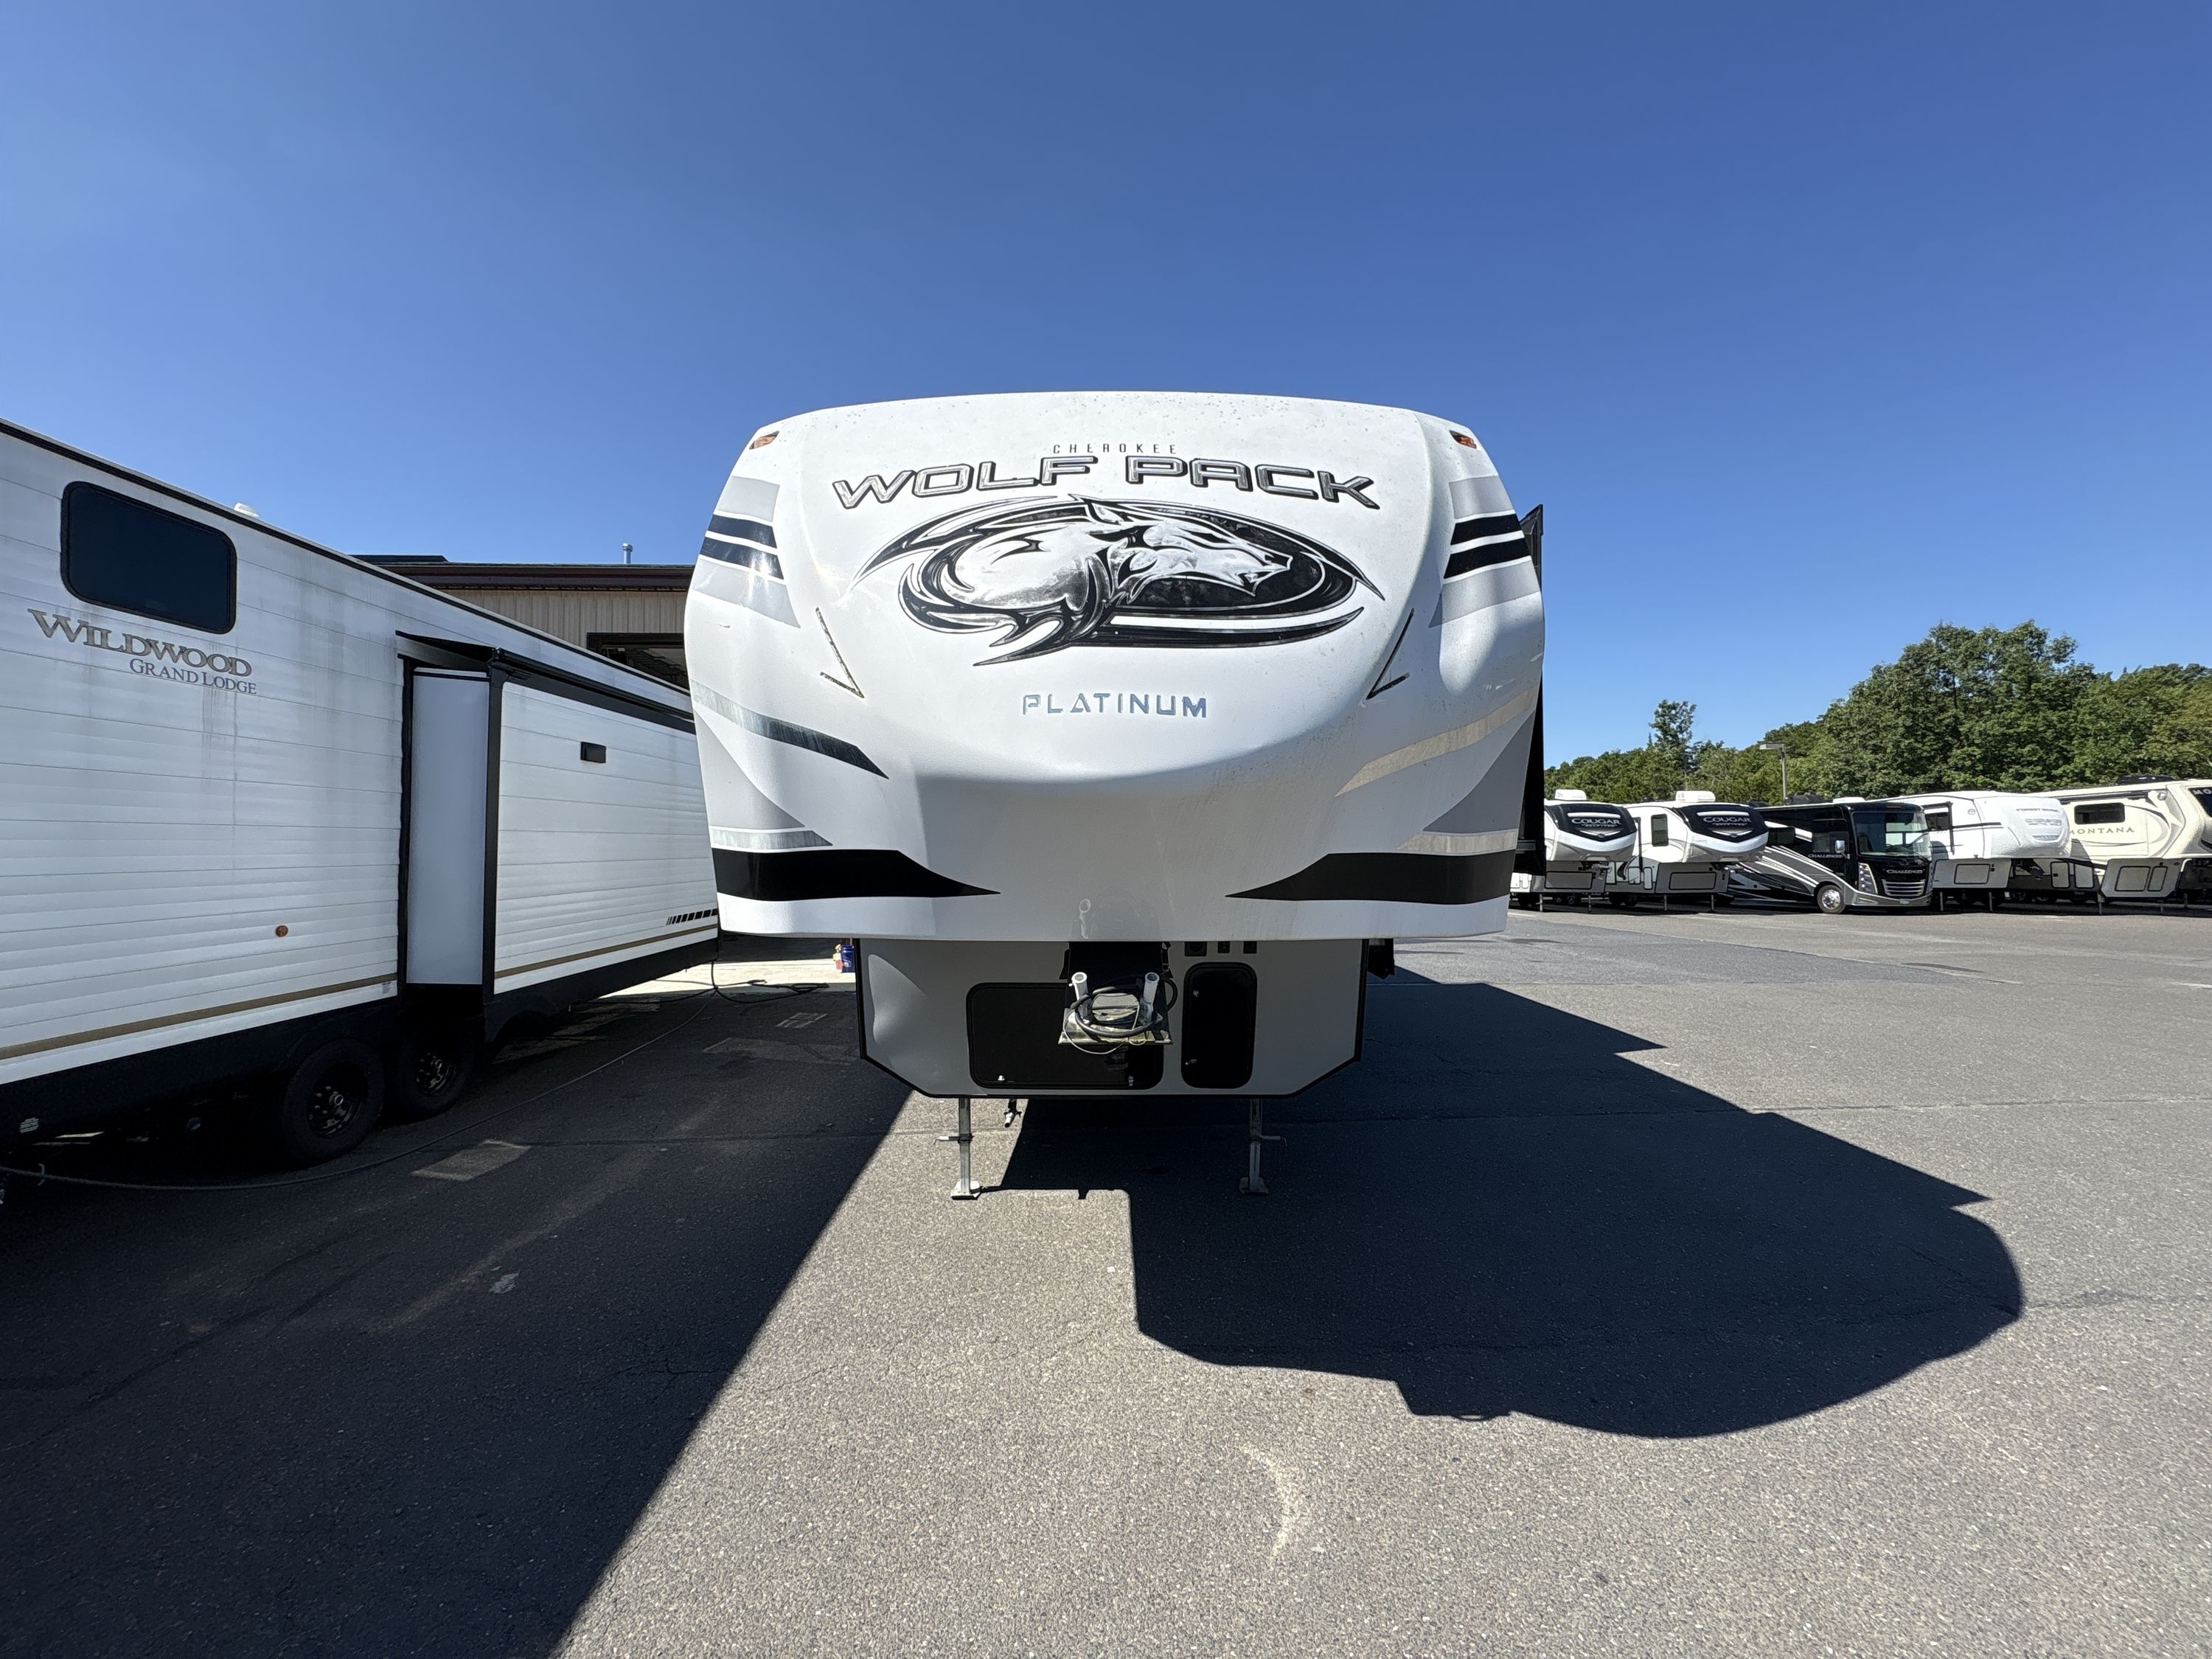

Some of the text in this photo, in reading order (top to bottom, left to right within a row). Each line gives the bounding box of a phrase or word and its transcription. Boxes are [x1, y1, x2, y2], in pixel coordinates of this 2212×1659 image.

[1053, 444, 1177, 454] CHEROKEE
[832, 456, 1380, 509] WOLF PACK
[27, 609, 252, 677] WILDWOOD
[130, 658, 257, 695] GRAND LODGE
[1022, 693, 1207, 718] PLATINUM
